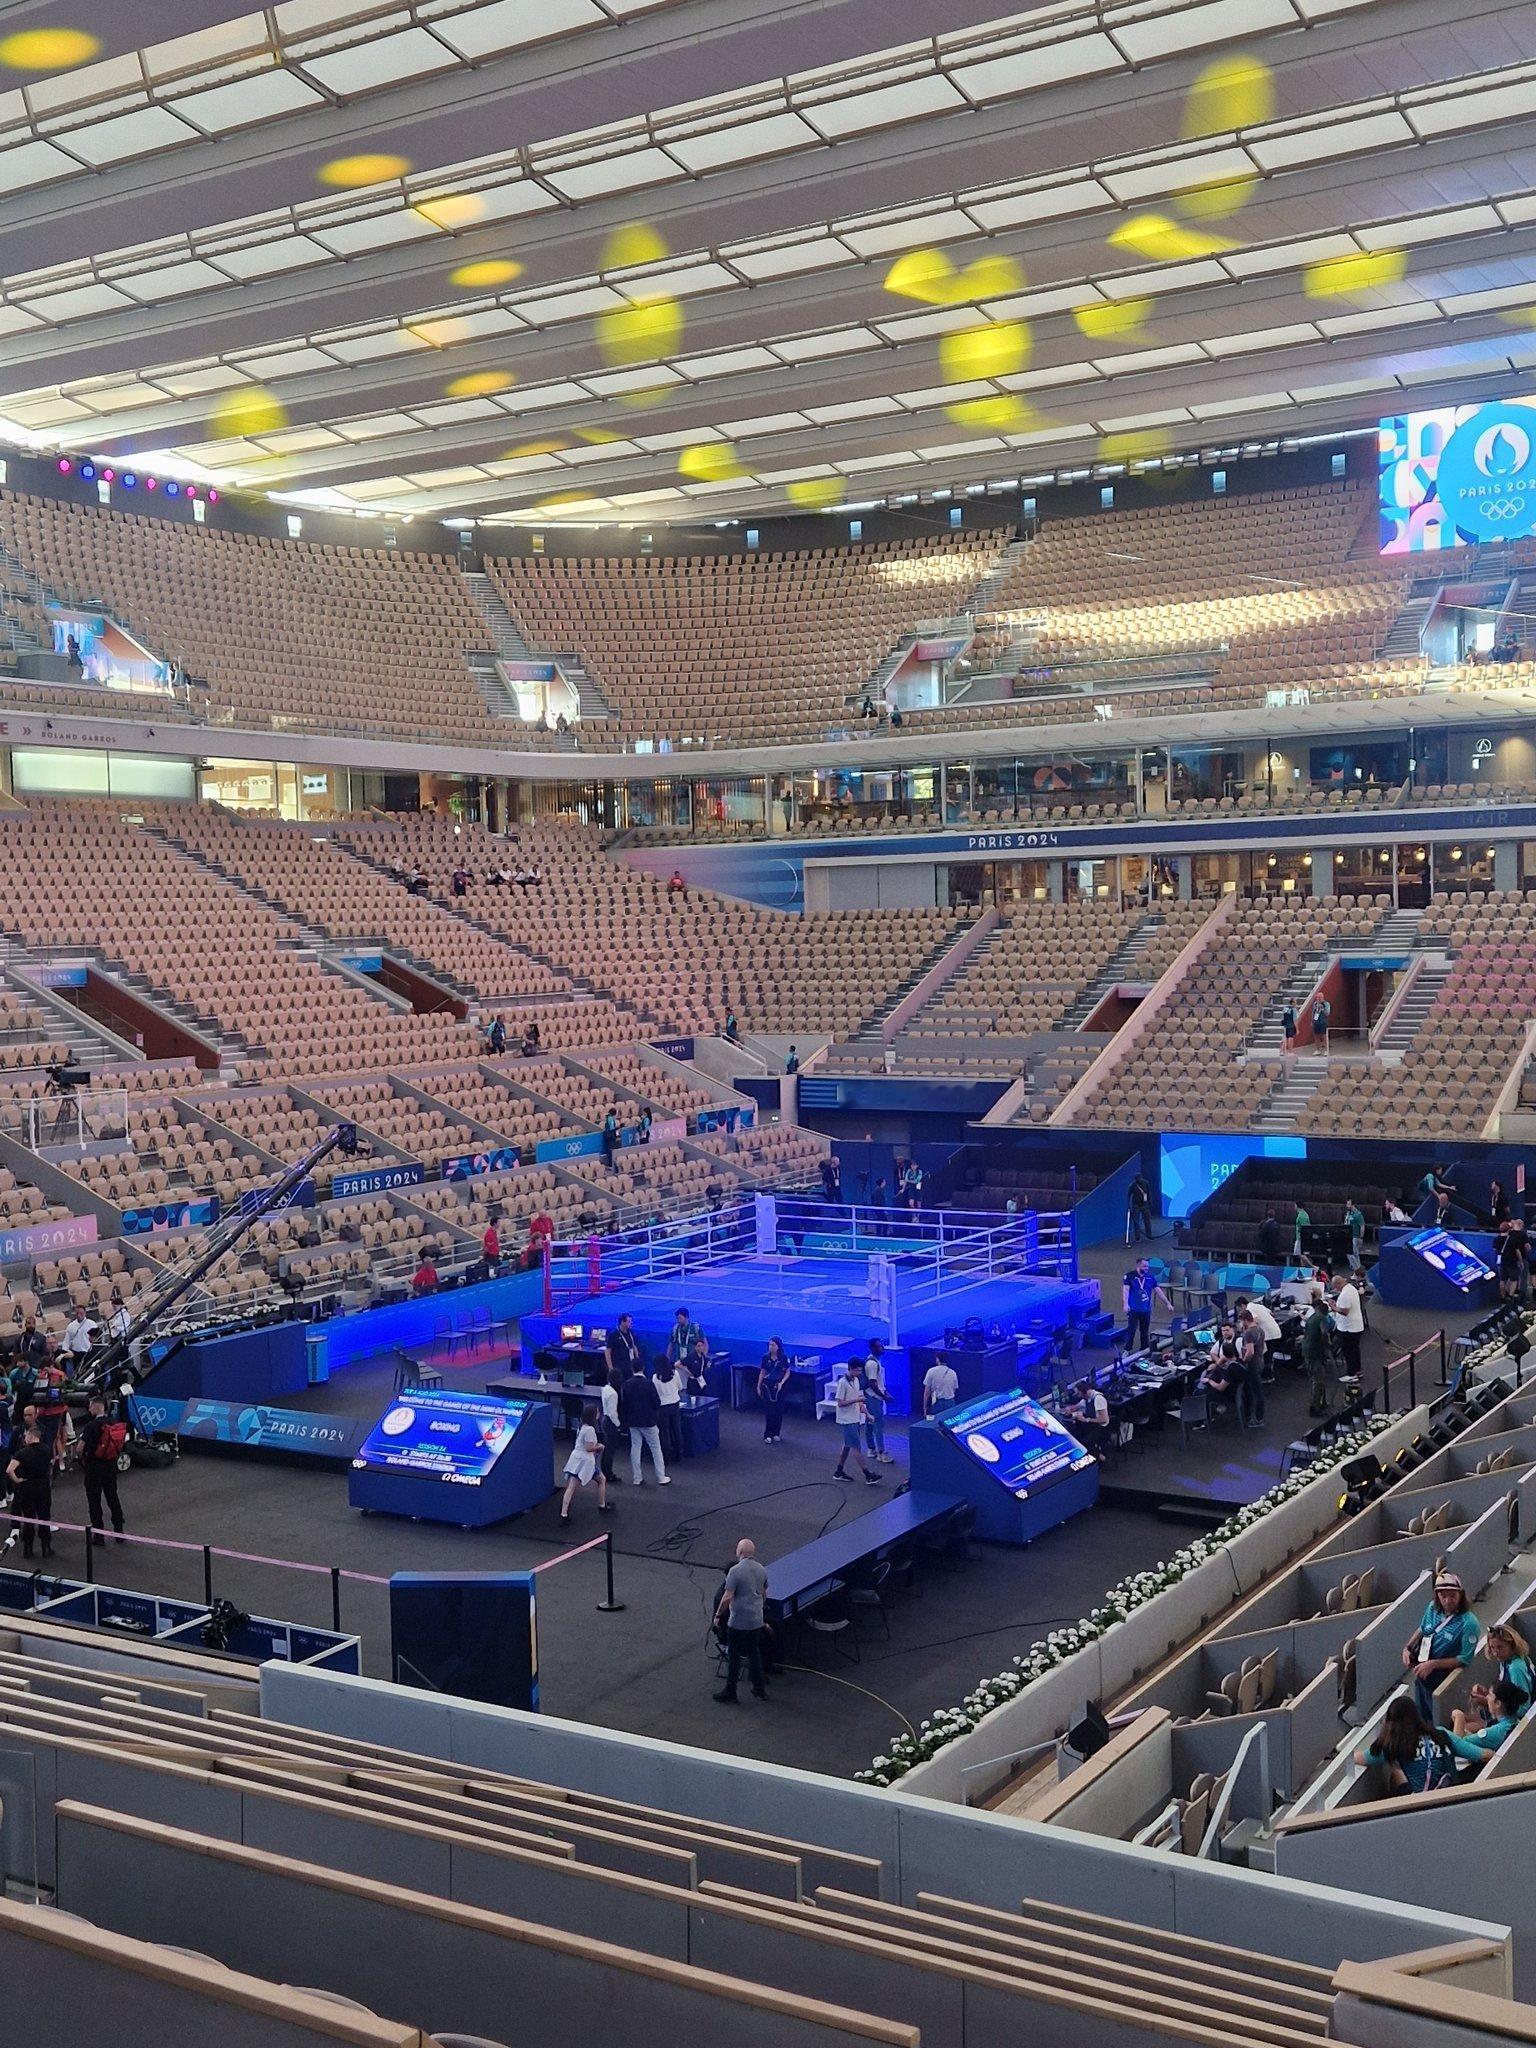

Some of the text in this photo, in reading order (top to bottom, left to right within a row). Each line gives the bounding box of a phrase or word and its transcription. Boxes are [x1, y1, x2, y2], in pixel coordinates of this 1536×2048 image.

[1459, 483, 1502, 498] PARIS
[969, 833, 1058, 848] PARIS 2024
[343, 1171, 418, 1195] PARIS 2024
[0, 1227, 88, 1255] RIS 2024
[270, 1421, 345, 1442] PARIS 2024
[429, 1420, 461, 1433] BOXING
[451, 1473, 481, 1486] OMEGA
